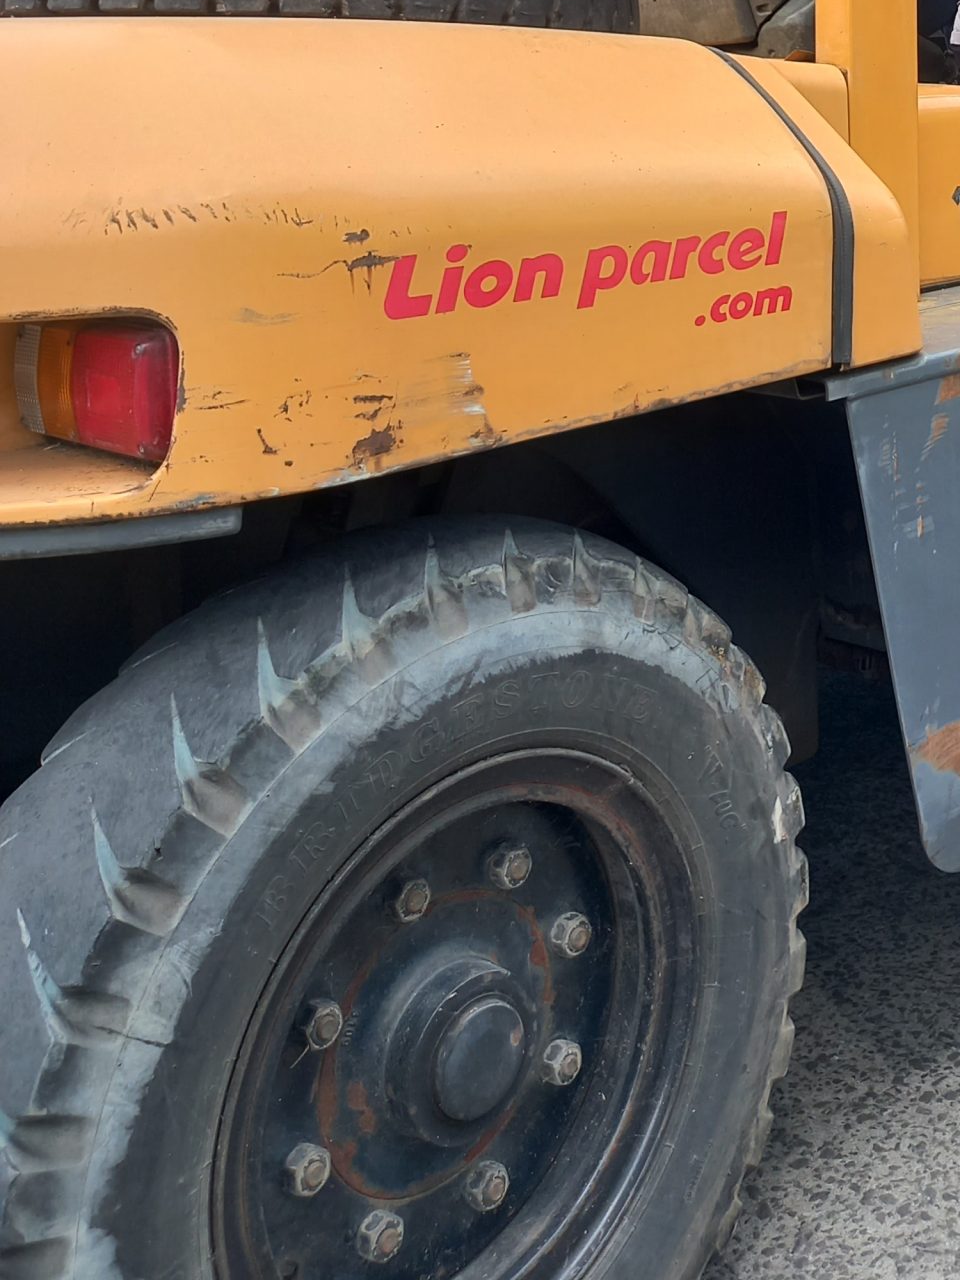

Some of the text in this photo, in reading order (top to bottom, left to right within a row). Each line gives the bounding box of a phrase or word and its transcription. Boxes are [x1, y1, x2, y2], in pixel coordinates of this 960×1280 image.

[384, 211, 788, 320] Lion parcel
[694, 285, 793, 326] .com
[255, 670, 660, 930] BRIDGESTONE
